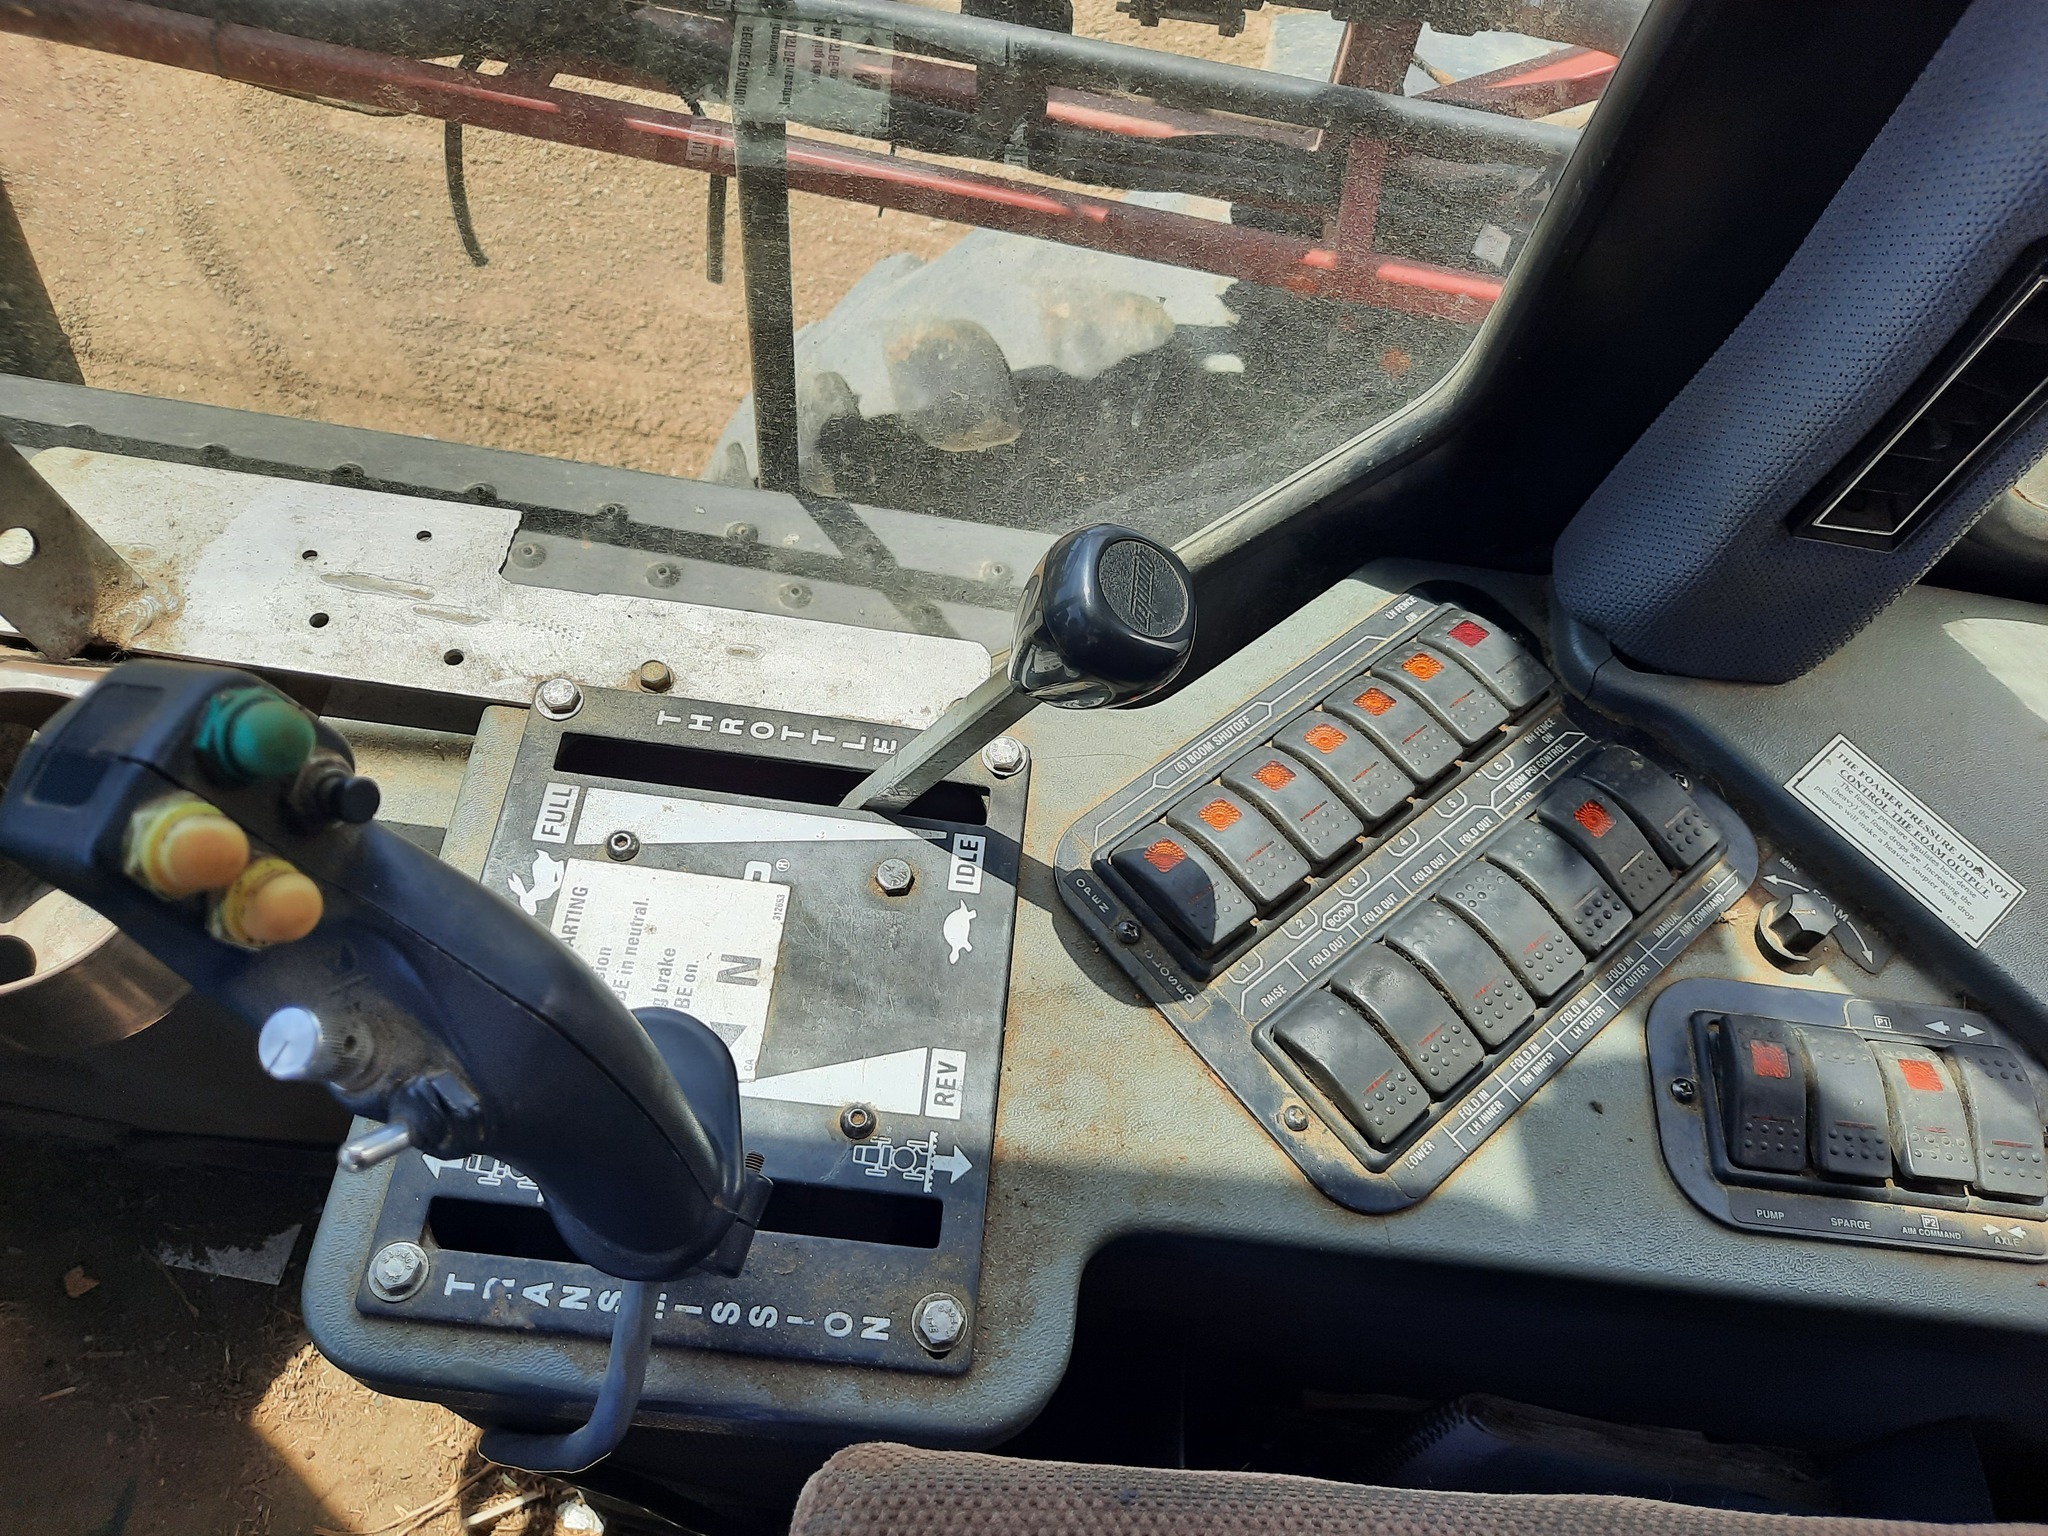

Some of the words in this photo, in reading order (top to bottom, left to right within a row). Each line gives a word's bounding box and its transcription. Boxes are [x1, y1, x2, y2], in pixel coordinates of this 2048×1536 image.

[1384, 606, 1398, 621] LH
[1397, 595, 1418, 614] FENCE
[1404, 611, 1419, 623] ON
[656, 709, 899, 755] THROTTLE
[1173, 759, 1191, 775] (6)
[1188, 743, 1215, 766] BOOM
[1212, 715, 1253, 746] SHUTOFF
[1523, 733, 1536, 745] RH
[1535, 717, 1557, 736] FENCE
[1541, 732, 1555, 744] ON
[1505, 773, 1526, 793] BOOM
[1525, 763, 1539, 778] PSI
[1537, 743, 1568, 768] CONTROL
[541, 786, 573, 836] FULL
[1514, 791, 1533, 807] AUTO
[1458, 827, 1479, 847] FOLD
[1476, 815, 1494, 833] OUT
[1836, 750, 1858, 771] THE
[1859, 769, 1903, 811] FOAMER
[1903, 808, 1958, 855] PRESSURE
[1957, 852, 1987, 880] DOES
[1986, 878, 2014, 901] NOT
[1839, 768, 1889, 813] CONTROL
[1890, 810, 1913, 832] THE
[1913, 829, 1946, 860] FOAM
[1946, 857, 1991, 899] OUTPUT.
[1840, 781, 1853, 795] The
[1853, 791, 1878, 816] foamer
[1877, 813, 1908, 841] pressure
[1907, 838, 1940, 868] regulates
[1939, 864, 1955, 879] how
[1956, 878, 1977, 899] dense
[955, 838, 979, 886] IDLE
[1813, 784, 1844, 811] pressure
[1844, 807, 1859, 823] will
[1858, 820, 1878, 840] make
[1883, 842, 1911, 869] heavier,
[1910, 865, 1938, 891] soupier
[1938, 887, 1957, 905] foam
[1957, 902, 1976, 923] drop.
[1831, 785, 1860, 811] (heavy)
[1858, 809, 1870, 821] the
[1870, 818, 1889, 836] foam
[1888, 832, 1909, 855] drops
[1923, 861, 1961, 902] Increasing
[1960, 894, 1973, 907] the
[1240, 962, 1251, 973] 1
[1295, 918, 1306, 930] 2
[1348, 876, 1359, 888] 3
[1399, 836, 1409, 847] 4
[1446, 798, 1458, 809] 5
[1493, 762, 1504, 771] 6
[1410, 866, 1432, 885] FOLD
[1429, 853, 1448, 872] OUT
[772, 893, 786, 924] 312653
[1075, 878, 1110, 914] OPEN
[1361, 906, 1383, 927] FOLD
[1380, 893, 1399, 913] OUT
[560, 886, 589, 948] ARTING
[625, 897, 650, 956] neutral.
[1326, 904, 1354, 929] BOOM
[1652, 911, 1683, 940] MANUAL
[1679, 921, 1694, 938] AIM
[1690, 893, 1726, 925] COMMAND
[616, 960, 635, 976] in
[1307, 947, 1329, 970] FOLD
[1328, 934, 1348, 955] OUT
[651, 947, 677, 994] brake
[684, 959, 700, 983] on.
[715, 953, 762, 987] N
[1145, 949, 1196, 1005] CLOSED
[1606, 962, 1628, 983] FOLD
[1623, 955, 1635, 970] IN
[1614, 981, 1628, 998] RH
[1624, 963, 1650, 989] OUTER
[612, 979, 631, 1002] BE
[674, 986, 695, 1009] BE
[1259, 983, 1288, 1009] RAISE
[1559, 1005, 1579, 1026] FOLD
[1576, 996, 1590, 1010] IN
[1569, 1024, 1585, 1040] LH
[1581, 1005, 1606, 1030] OUTER
[1876, 1017, 1889, 1028] P1
[744, 1058, 755, 1072] CA
[1509, 1051, 1530, 1072] FOLD
[1528, 1042, 1542, 1056] IN
[1519, 1070, 1535, 1087] RH
[1531, 1052, 1557, 1076] INNER
[934, 1060, 958, 1107] REV
[1458, 1097, 1480, 1120] FOLD
[1477, 1089, 1491, 1103] IN
[1467, 1119, 1483, 1136] LH
[1480, 1100, 1505, 1124] INNER
[1404, 1139, 1437, 1171] LOWER
[1756, 1209, 1785, 1221] PUMP
[1830, 1217, 1872, 1231] SPARGE
[1924, 1217, 1937, 1228] P2
[1902, 1226, 1917, 1236] AIM
[1918, 1228, 1962, 1240] COMMAND
[1994, 1236, 2021, 1247] AXLE
[443, 1272, 892, 1342] TRANSISSION
